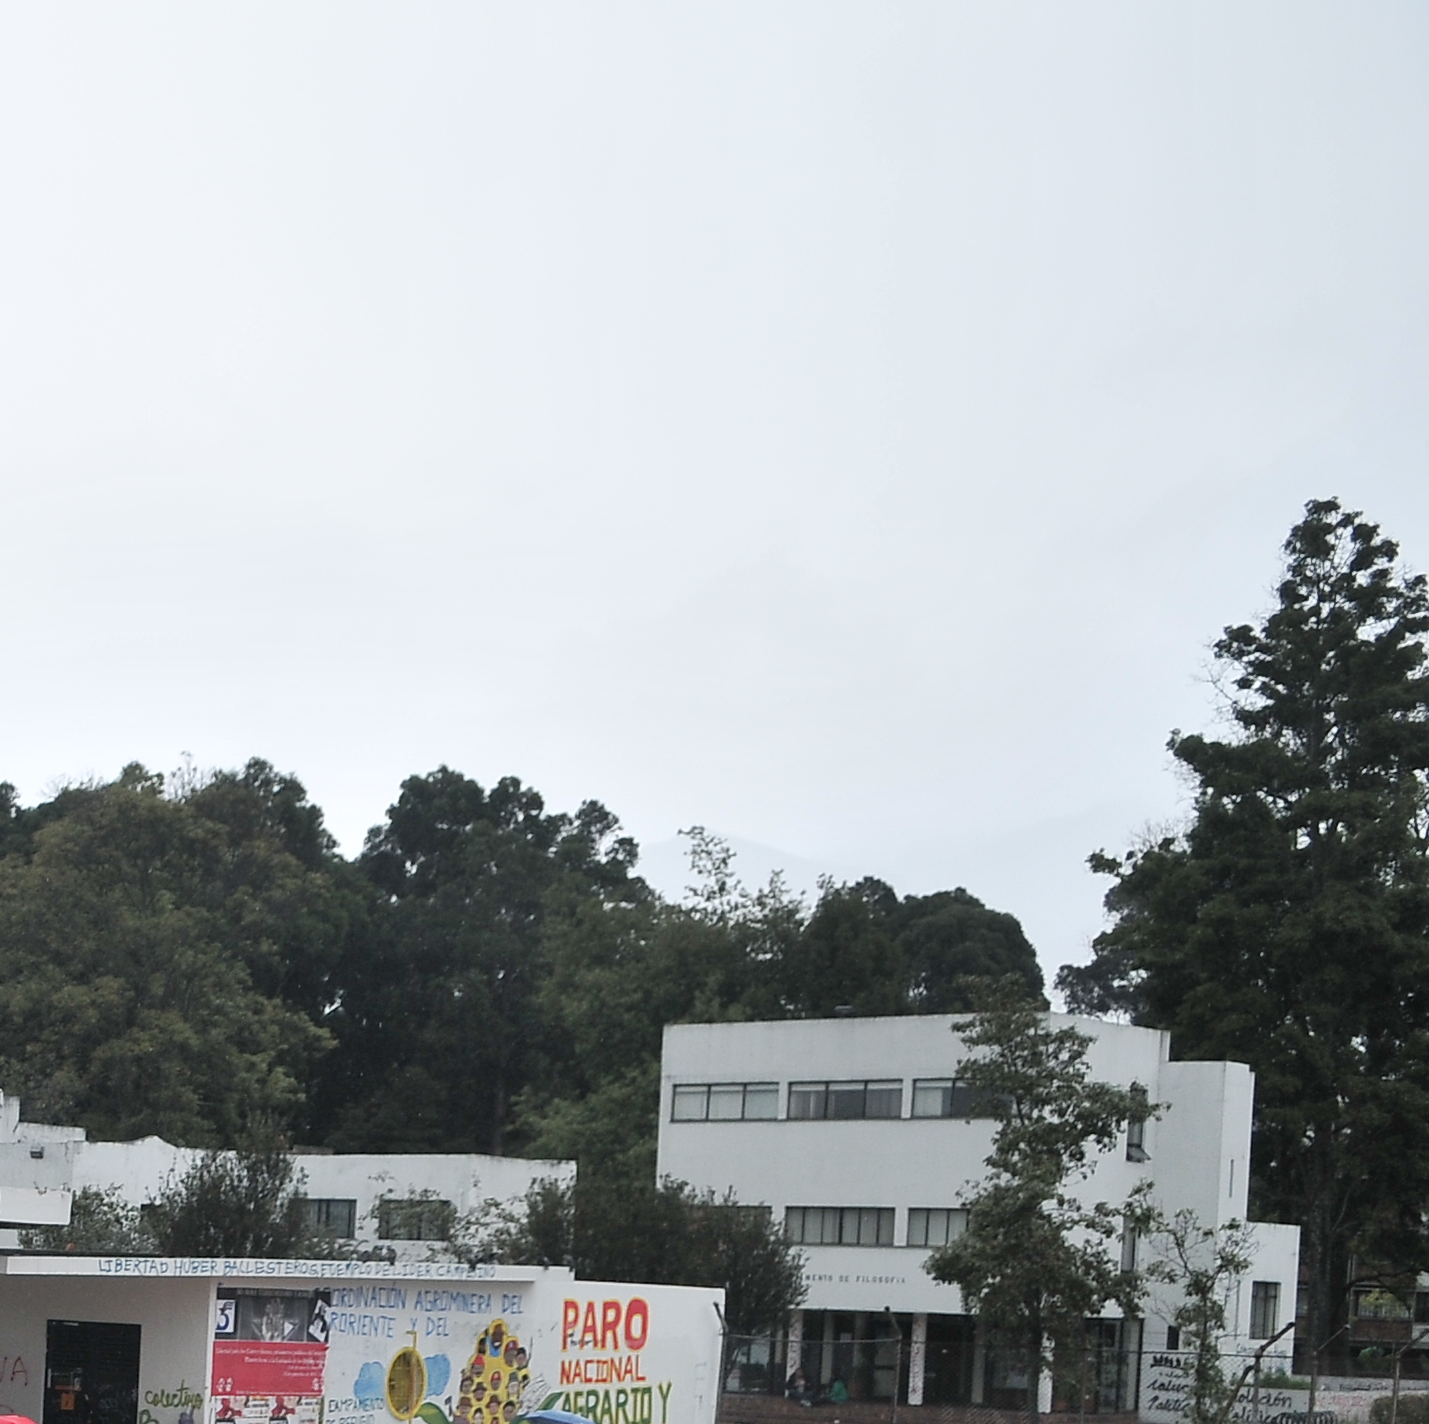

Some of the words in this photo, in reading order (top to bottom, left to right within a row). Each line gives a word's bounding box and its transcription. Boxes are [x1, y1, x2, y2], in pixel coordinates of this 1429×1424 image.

[98, 1258, 168, 1275] LIBERTAD
[174, 1259, 219, 1276] HUBER
[501, 1292, 525, 1316] DEL
[425, 1316, 450, 1337] DEL
[560, 1296, 651, 1353] PARO
[559, 1353, 647, 1385] NACIONAL
